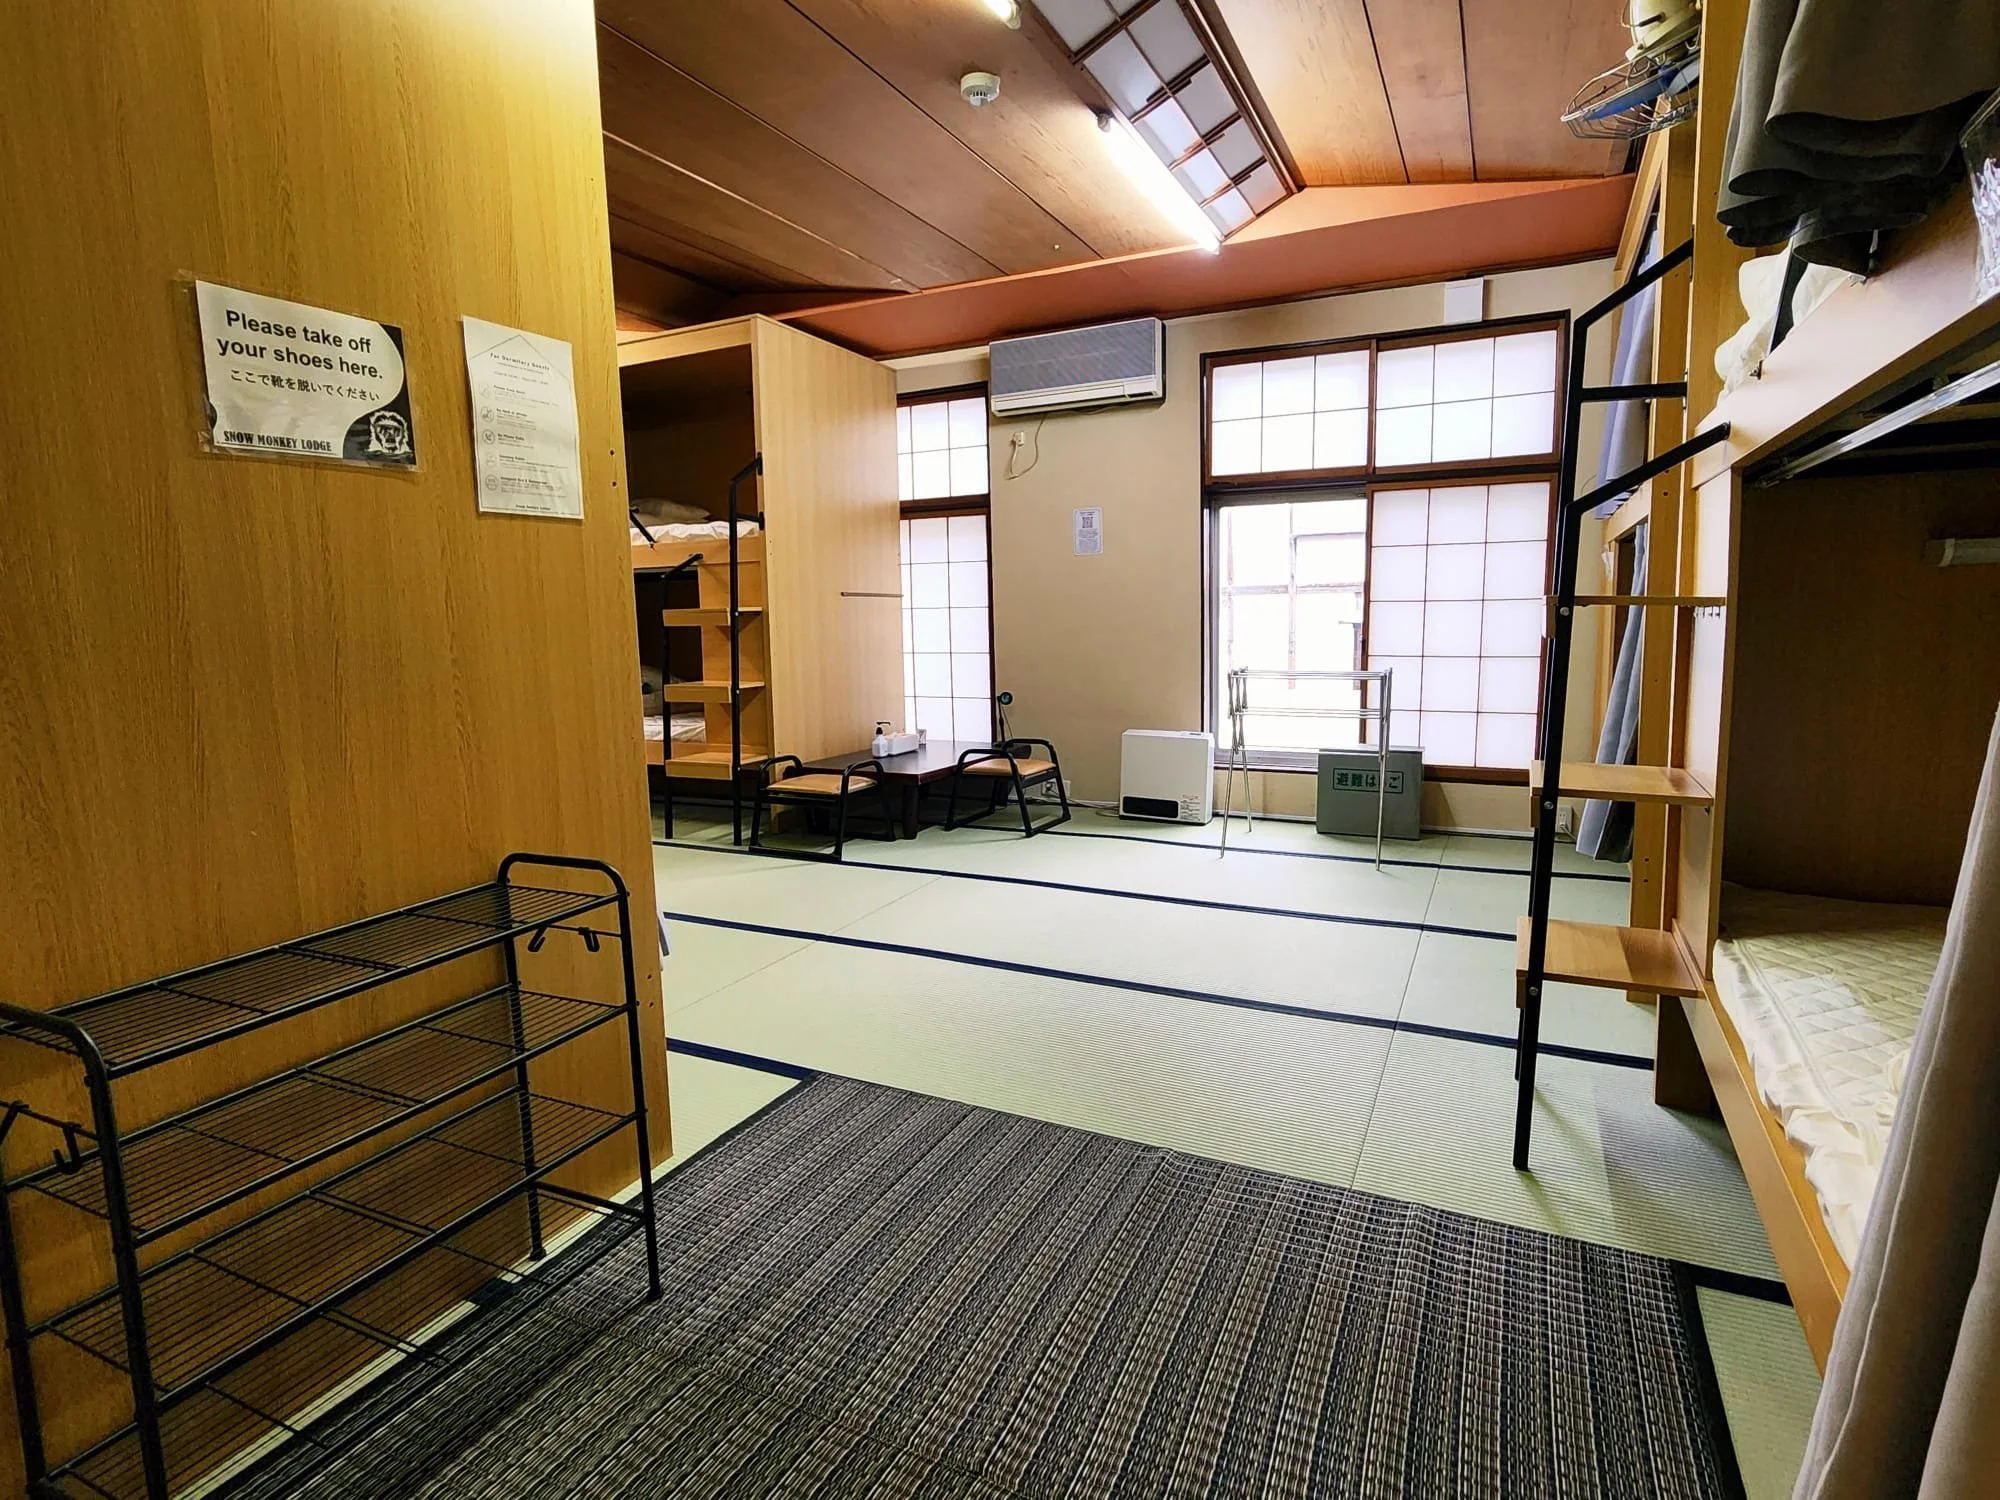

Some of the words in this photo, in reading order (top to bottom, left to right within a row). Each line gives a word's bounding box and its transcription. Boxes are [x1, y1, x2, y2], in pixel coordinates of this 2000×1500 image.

[226, 309, 297, 339] Please
[302, 325, 343, 348] take
[348, 337, 371, 354] off
[216, 338, 267, 357] your
[273, 346, 333, 370] shoes
[339, 356, 383, 379] here.
[230, 369, 380, 401] ここで靴を脱いでください
[223, 430, 254, 445] SNOW
[257, 433, 297, 449] MONKEY
[301, 438, 332, 452] LODGE
